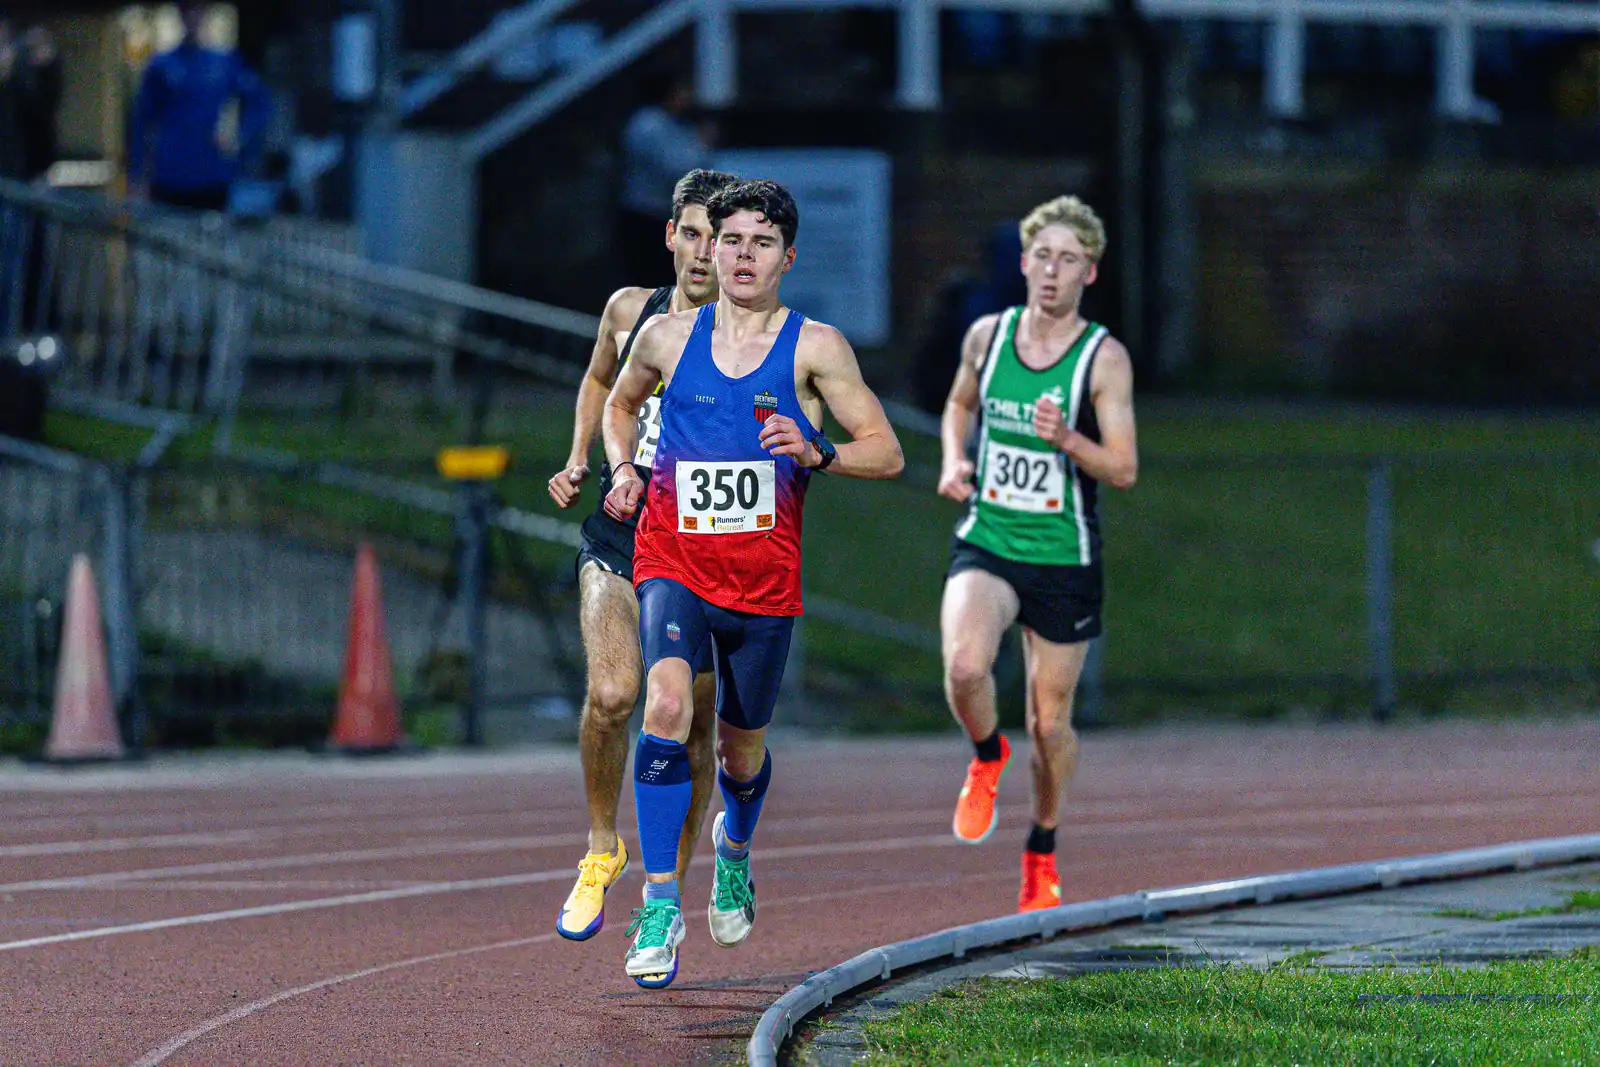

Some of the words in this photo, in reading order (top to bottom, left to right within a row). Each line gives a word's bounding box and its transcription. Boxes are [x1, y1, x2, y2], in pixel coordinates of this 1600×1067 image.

[695, 394, 715, 404] TACTIC
[986, 398, 1038, 422] CHILT
[995, 452, 1049, 493] 302
[690, 468, 759, 511] 350
[716, 515, 746, 524] Runners'
[716, 524, 744, 532] Retreat
